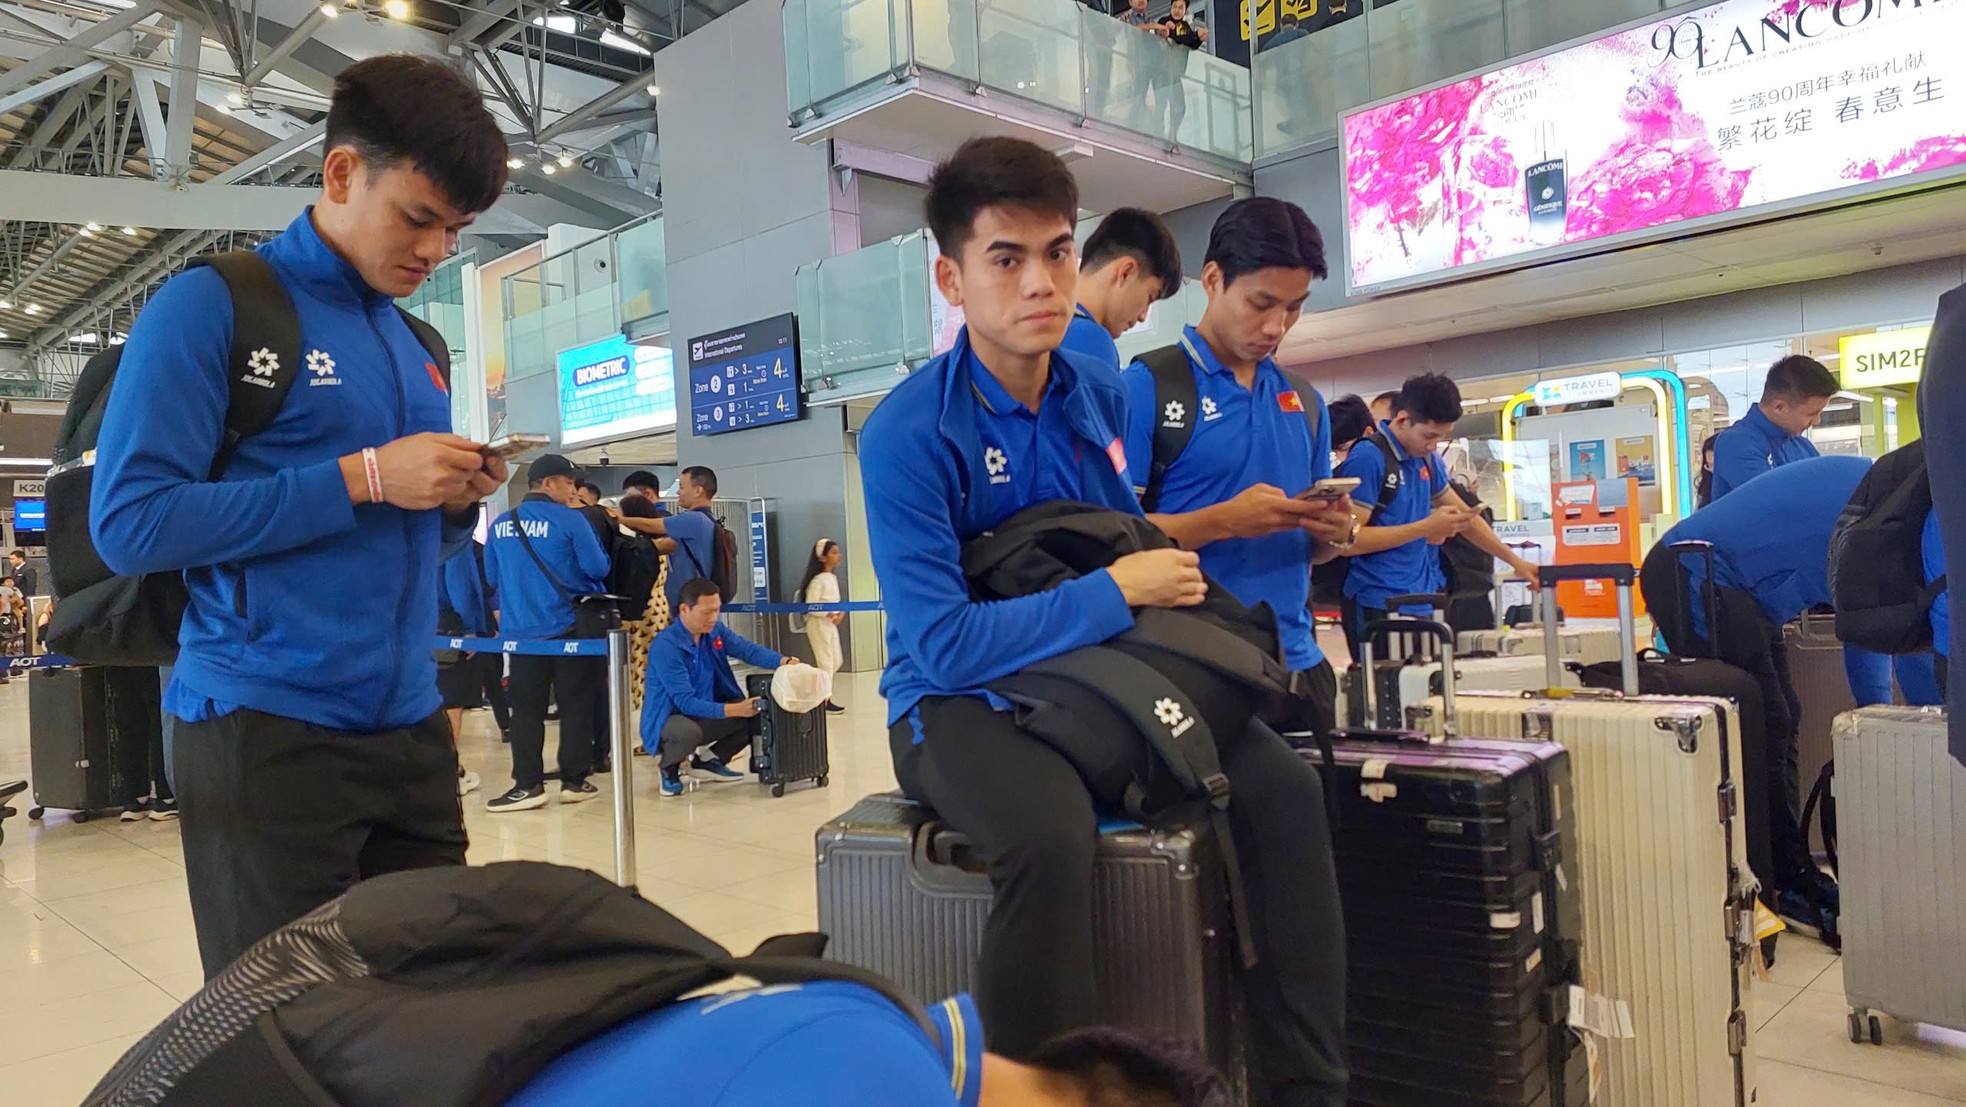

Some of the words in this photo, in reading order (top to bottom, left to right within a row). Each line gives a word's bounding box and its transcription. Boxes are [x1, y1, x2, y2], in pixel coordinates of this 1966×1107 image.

[1697, 0, 1943, 69] LANCO
[1717, 108, 1813, 151] 繁花绽
[1835, 76, 1945, 124] 春意生
[576, 357, 627, 385] BIOMETRIC
[774, 357, 783, 379] 4
[694, 383, 709, 394] Zone
[1563, 379, 1614, 391] TRAVEL
[776, 394, 784, 412] 4
[696, 414, 709, 423] Zone
[19, 483, 45, 493] K20
[494, 520, 549, 539] VIENAM
[450, 638, 464, 649] AOT
[503, 641, 518, 651] AOT
[563, 642, 579, 653] AOT
[9, 657, 41, 667] AOT
